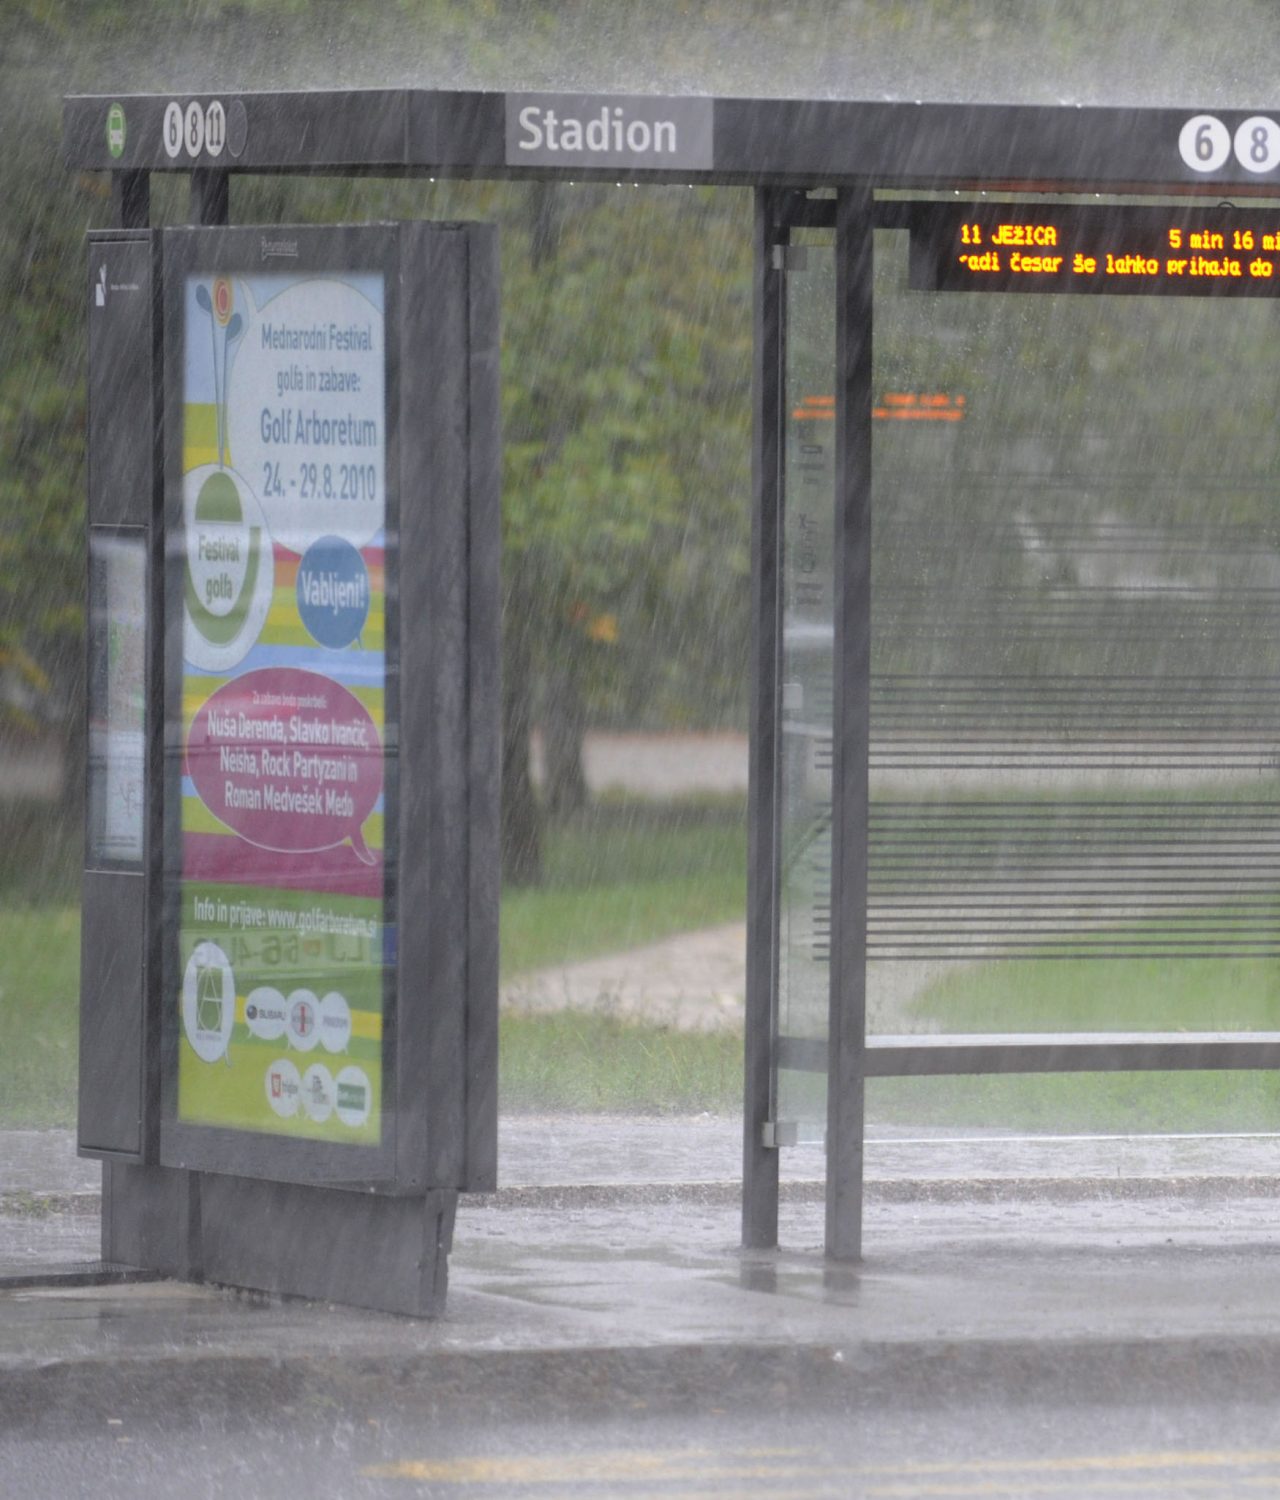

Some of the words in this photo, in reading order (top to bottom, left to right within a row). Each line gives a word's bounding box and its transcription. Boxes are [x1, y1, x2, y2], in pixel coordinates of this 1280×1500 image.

[170, 110, 178, 146] 6
[190, 110, 198, 146] 8
[209, 110, 221, 147] 11
[518, 105, 677, 152] Stadion
[1195, 124, 1213, 160] 6
[1250, 126, 1269, 162] 8
[960, 225, 981, 244] 11
[992, 225, 1057, 246] JEŽICA
[1169, 229, 1182, 248] 5
[1190, 232, 1224, 250] min
[1233, 232, 1254, 250] 16
[1011, 253, 1064, 273] česar
[1073, 254, 1097, 274] še
[1106, 255, 1159, 275] lahko
[1167, 256, 1243, 277] prihaja
[1249, 258, 1273, 277] do
[262, 323, 326, 351] Mednarodni
[329, 323, 373, 351] Festival
[277, 364, 304, 396] golfa
[306, 364, 316, 392] in
[318, 365, 361, 393] zabave:
[260, 407, 292, 444] Golf
[294, 408, 377, 447] Arboretum
[263, 461, 286, 497] 24.
[340, 463, 376, 501] 2010
[199, 533, 240, 562] Festival
[206, 572, 233, 605] golfa
[301, 571, 365, 616] Vabljeni!
[207, 709, 236, 737] Nuša
[239, 712, 287, 744] Derenda,
[290, 716, 328, 744] Slavko
[220, 747, 259, 779] Neisha,
[262, 749, 290, 777] Rock
[293, 751, 347, 785] Partyzani
[347, 757, 358, 783] in
[225, 781, 261, 809] Roman
[264, 784, 323, 815] Medvešek
[325, 788, 353, 817] Medo
[194, 897, 215, 921] Info
[217, 899, 227, 922] in
[229, 901, 266, 930] prijave:
